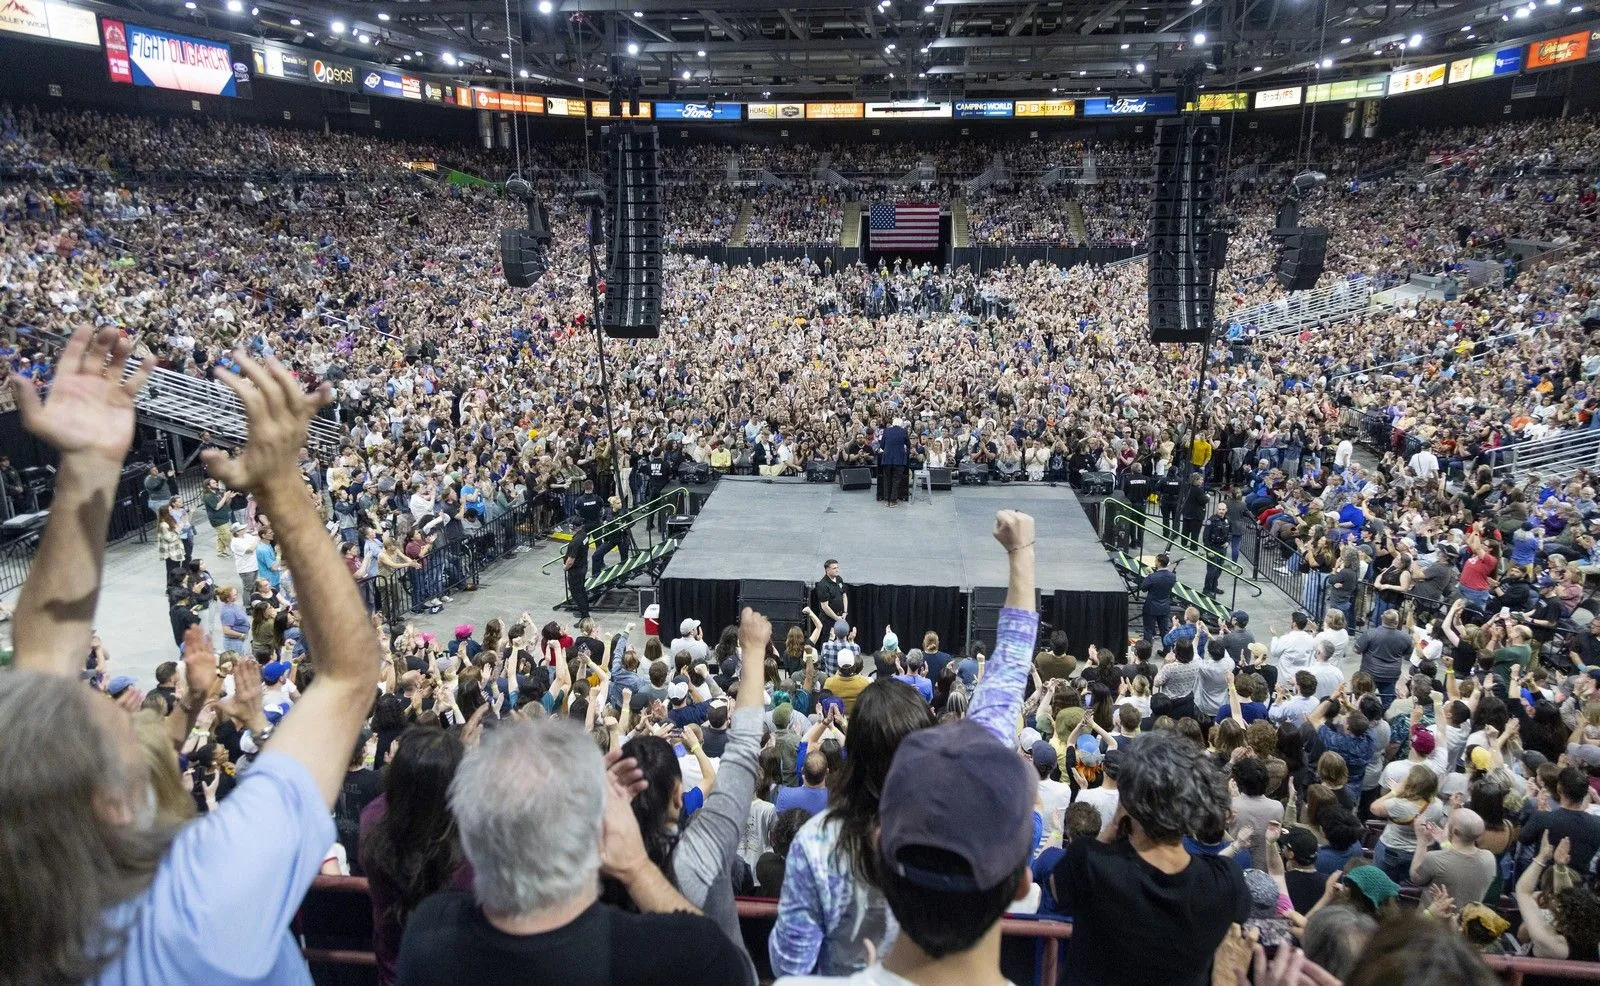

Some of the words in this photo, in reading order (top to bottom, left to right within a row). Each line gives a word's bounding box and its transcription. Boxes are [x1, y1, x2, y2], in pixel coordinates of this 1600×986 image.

[131, 32, 167, 63] FIGHT
[168, 38, 233, 72] OLIGARCHY
[326, 66, 354, 84] pepsi
[682, 103, 714, 118] Ford
[956, 103, 986, 111] CAMPING
[987, 102, 1013, 110] WORLD
[1040, 104, 1073, 112] SUPPLY
[1111, 98, 1147, 113] Ford
